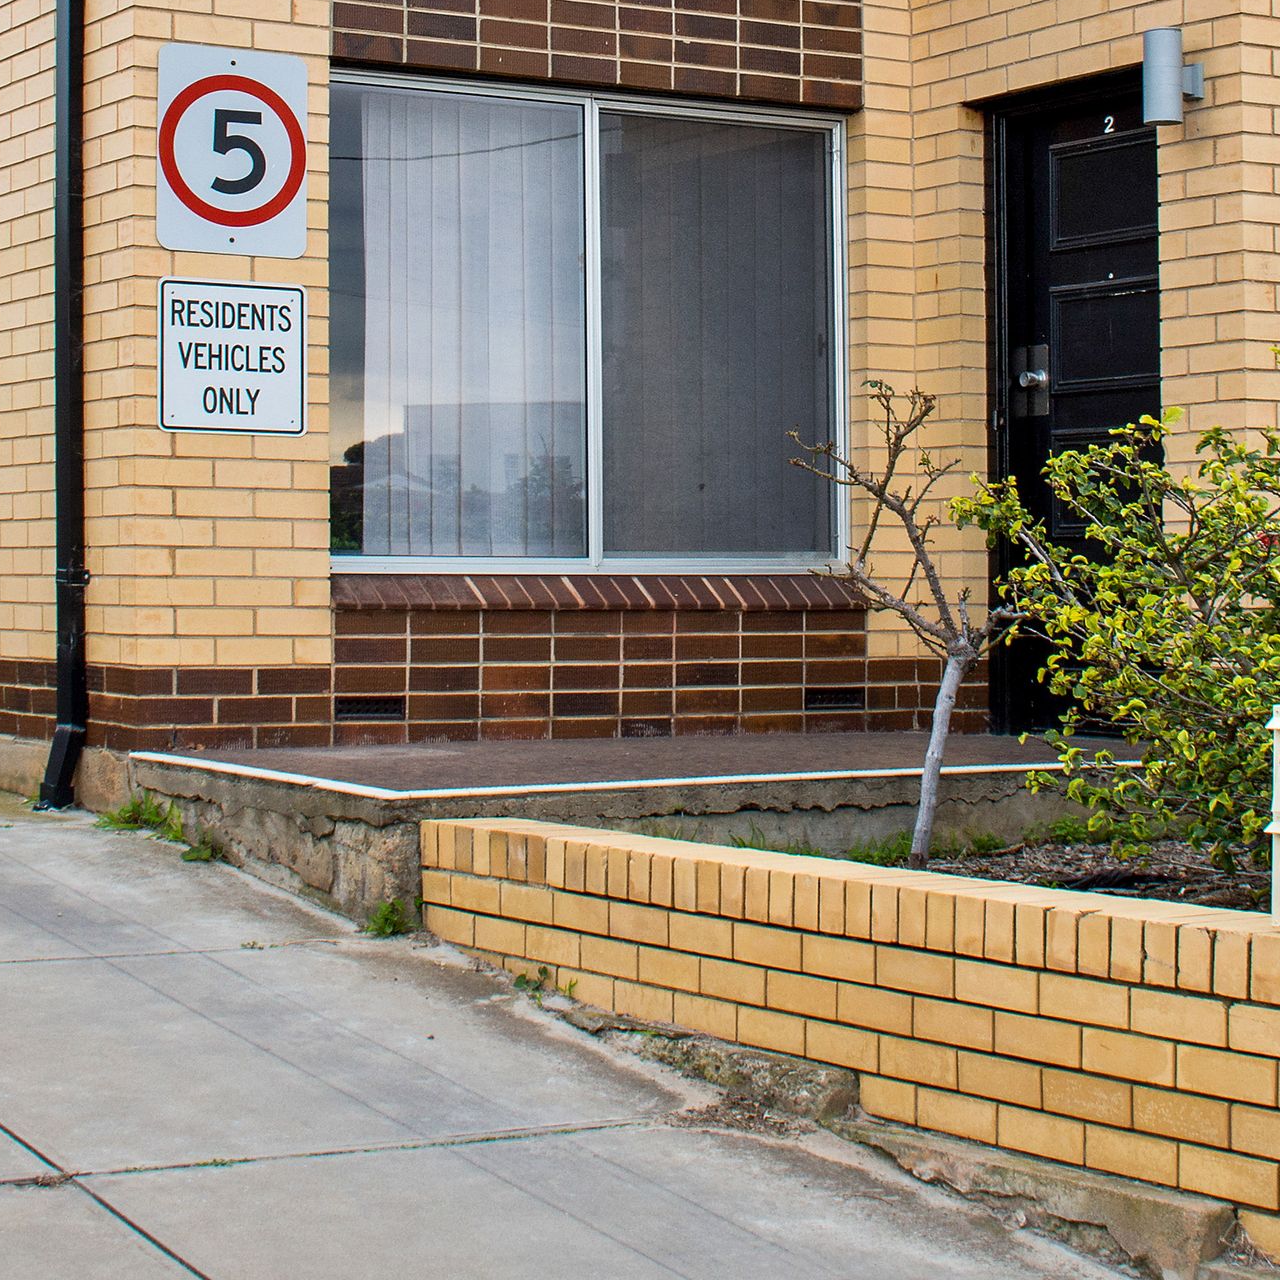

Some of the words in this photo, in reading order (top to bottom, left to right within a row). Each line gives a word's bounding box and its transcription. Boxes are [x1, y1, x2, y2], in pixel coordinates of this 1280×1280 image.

[1104, 116, 1115, 134] 2
[210, 108, 267, 195] 5
[170, 298, 292, 333] RESIDENTS
[178, 341, 286, 374] VEHICLES
[202, 386, 261, 416] ONLY
